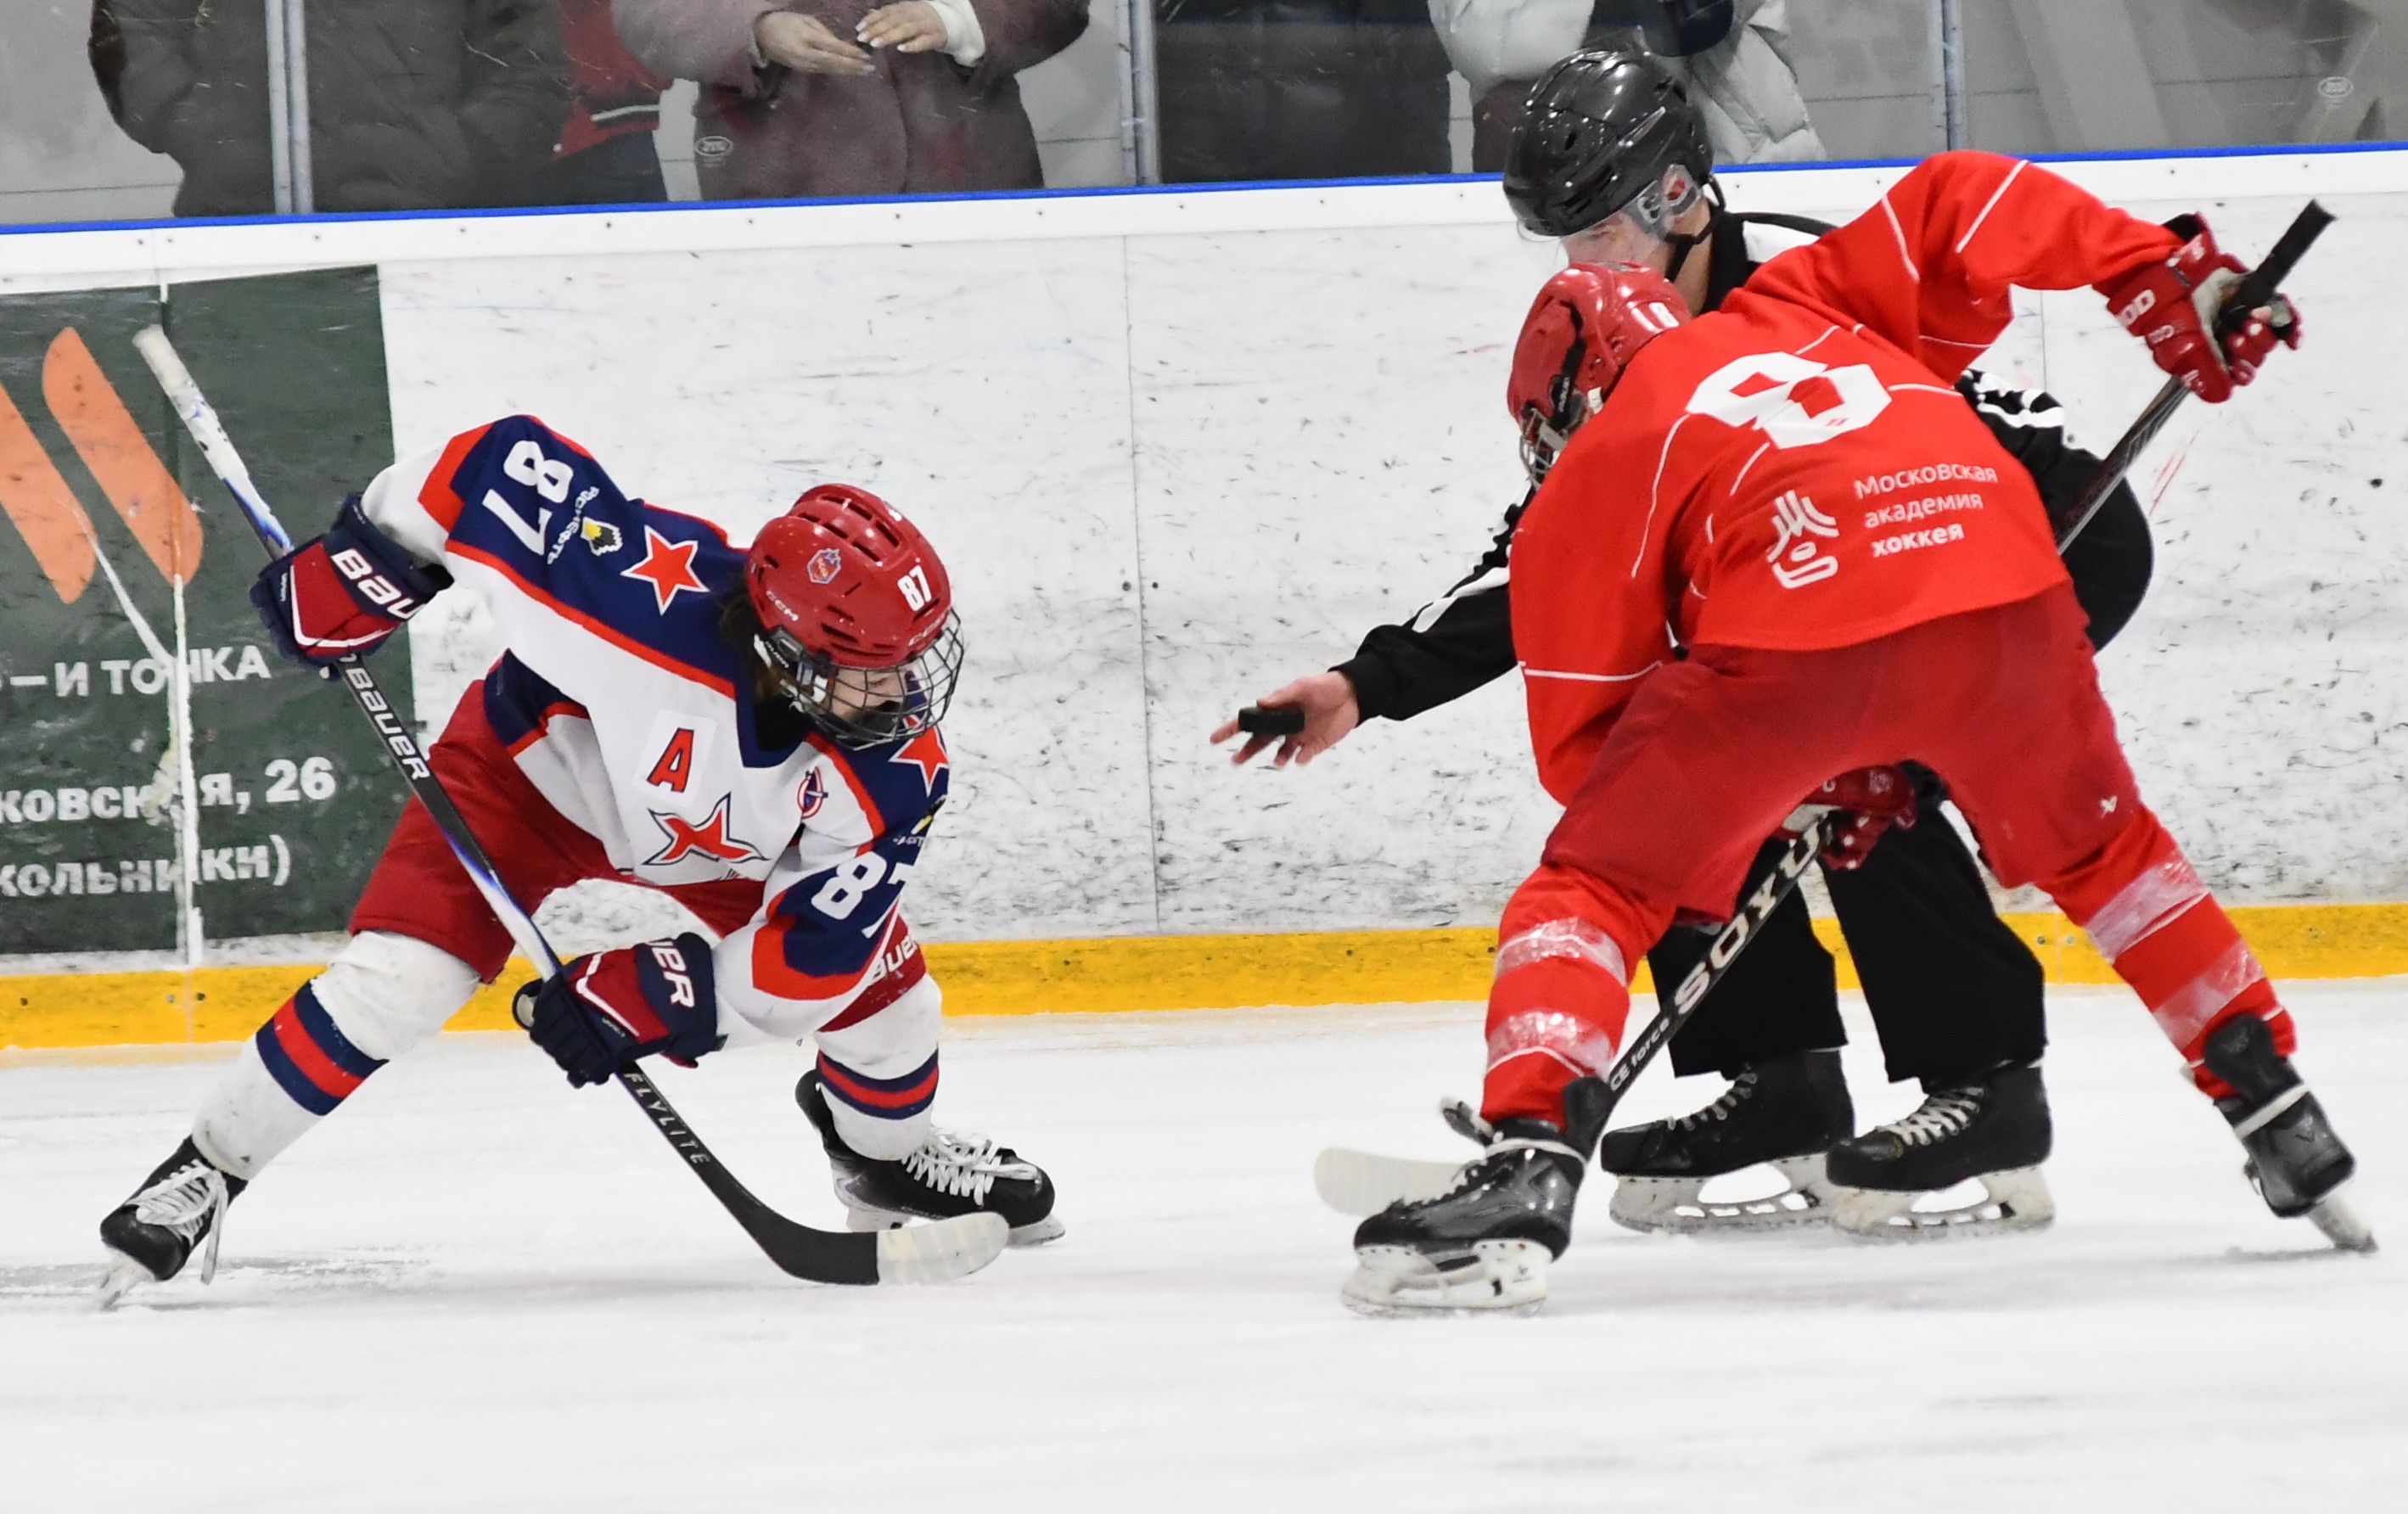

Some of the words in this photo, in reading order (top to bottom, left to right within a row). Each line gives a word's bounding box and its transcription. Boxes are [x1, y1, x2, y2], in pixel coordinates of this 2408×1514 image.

[481, 440, 574, 556] 87
[1854, 463, 1999, 500] Московская
[1865, 491, 1984, 529] академия
[1872, 522, 1966, 558] хоккея
[897, 564, 933, 612] 87
[265, 755, 337, 804] 26
[624, 1071, 711, 1164] FLYLITE
